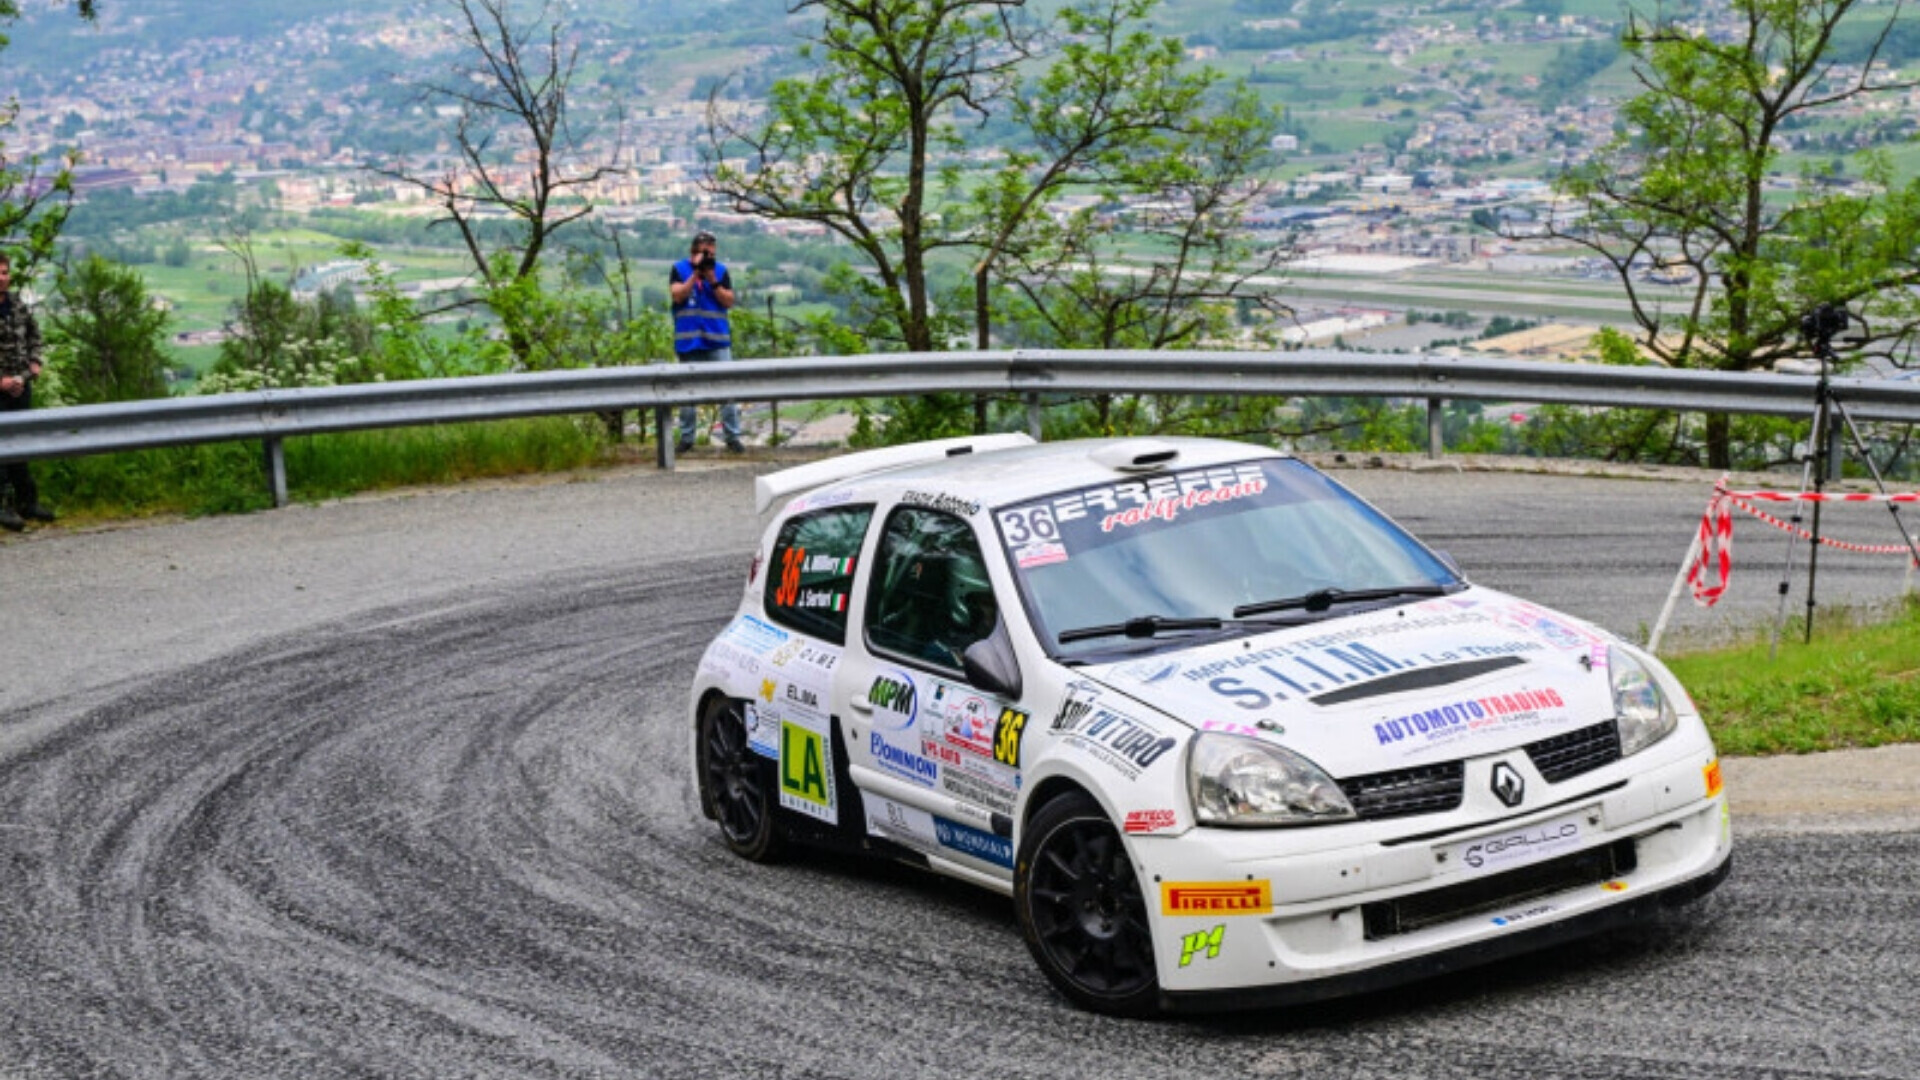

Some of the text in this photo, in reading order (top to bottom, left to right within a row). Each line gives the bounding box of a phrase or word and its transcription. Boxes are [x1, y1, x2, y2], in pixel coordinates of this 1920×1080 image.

[1054, 465, 1266, 522] ERREFFE
[1004, 508, 1055, 542] 36
[776, 547, 805, 607] 36
[782, 726, 826, 800] LA
[995, 709, 1025, 766] 36
[1485, 823, 1578, 855] GALLO
[1168, 887, 1261, 910] PIRELLI
